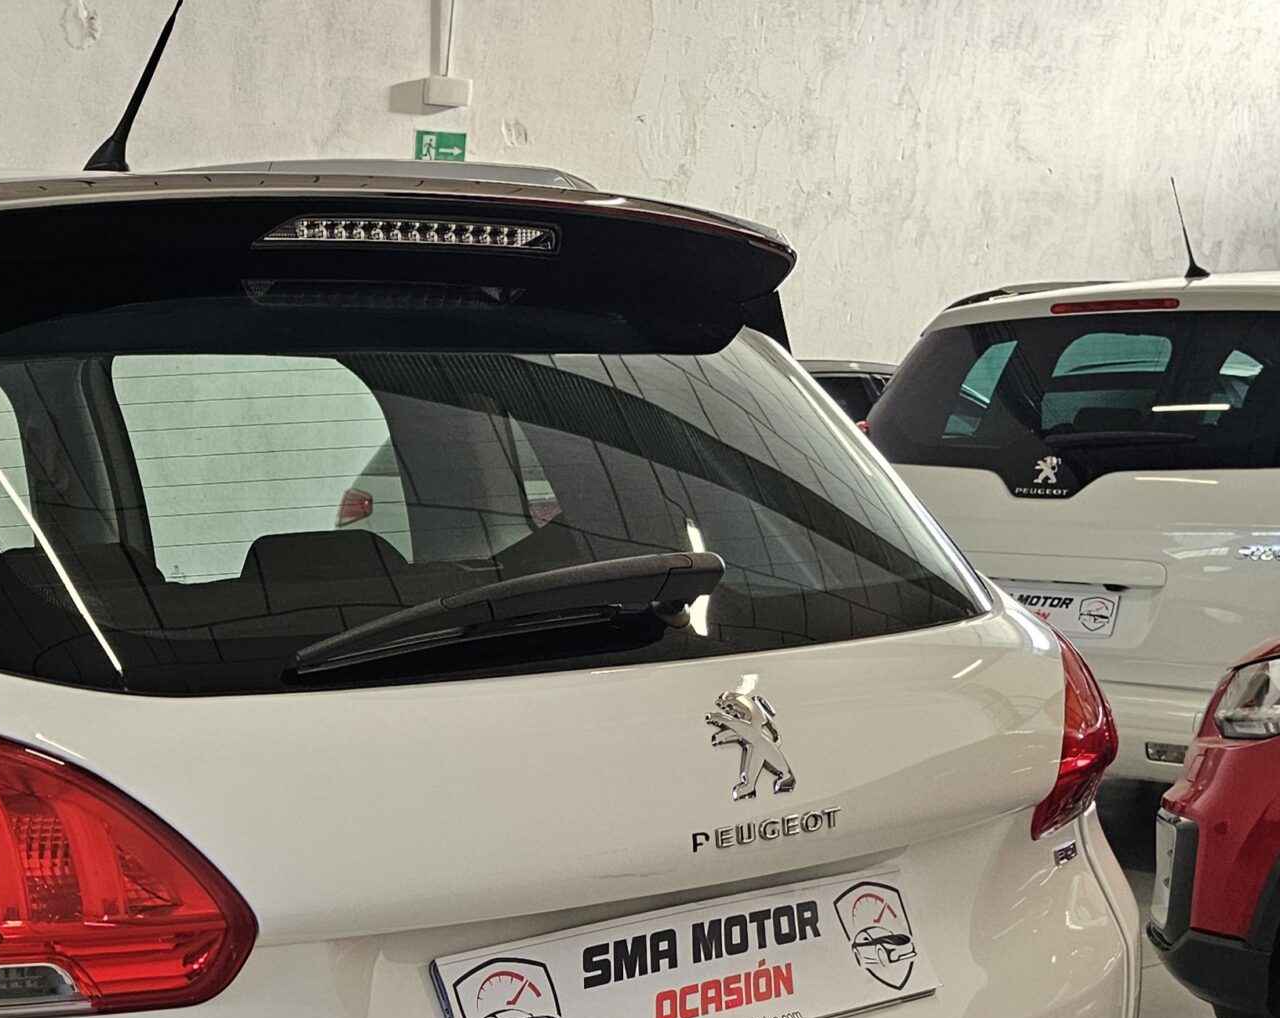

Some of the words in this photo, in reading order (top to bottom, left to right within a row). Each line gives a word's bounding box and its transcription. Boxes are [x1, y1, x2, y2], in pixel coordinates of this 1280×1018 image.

[1015, 487, 1069, 495] PEUGEOT
[1017, 594, 1074, 609] MOTOR
[691, 806, 841, 853] PEUGEOT
[583, 929, 678, 989] SMA
[692, 901, 821, 963] MOTOR
